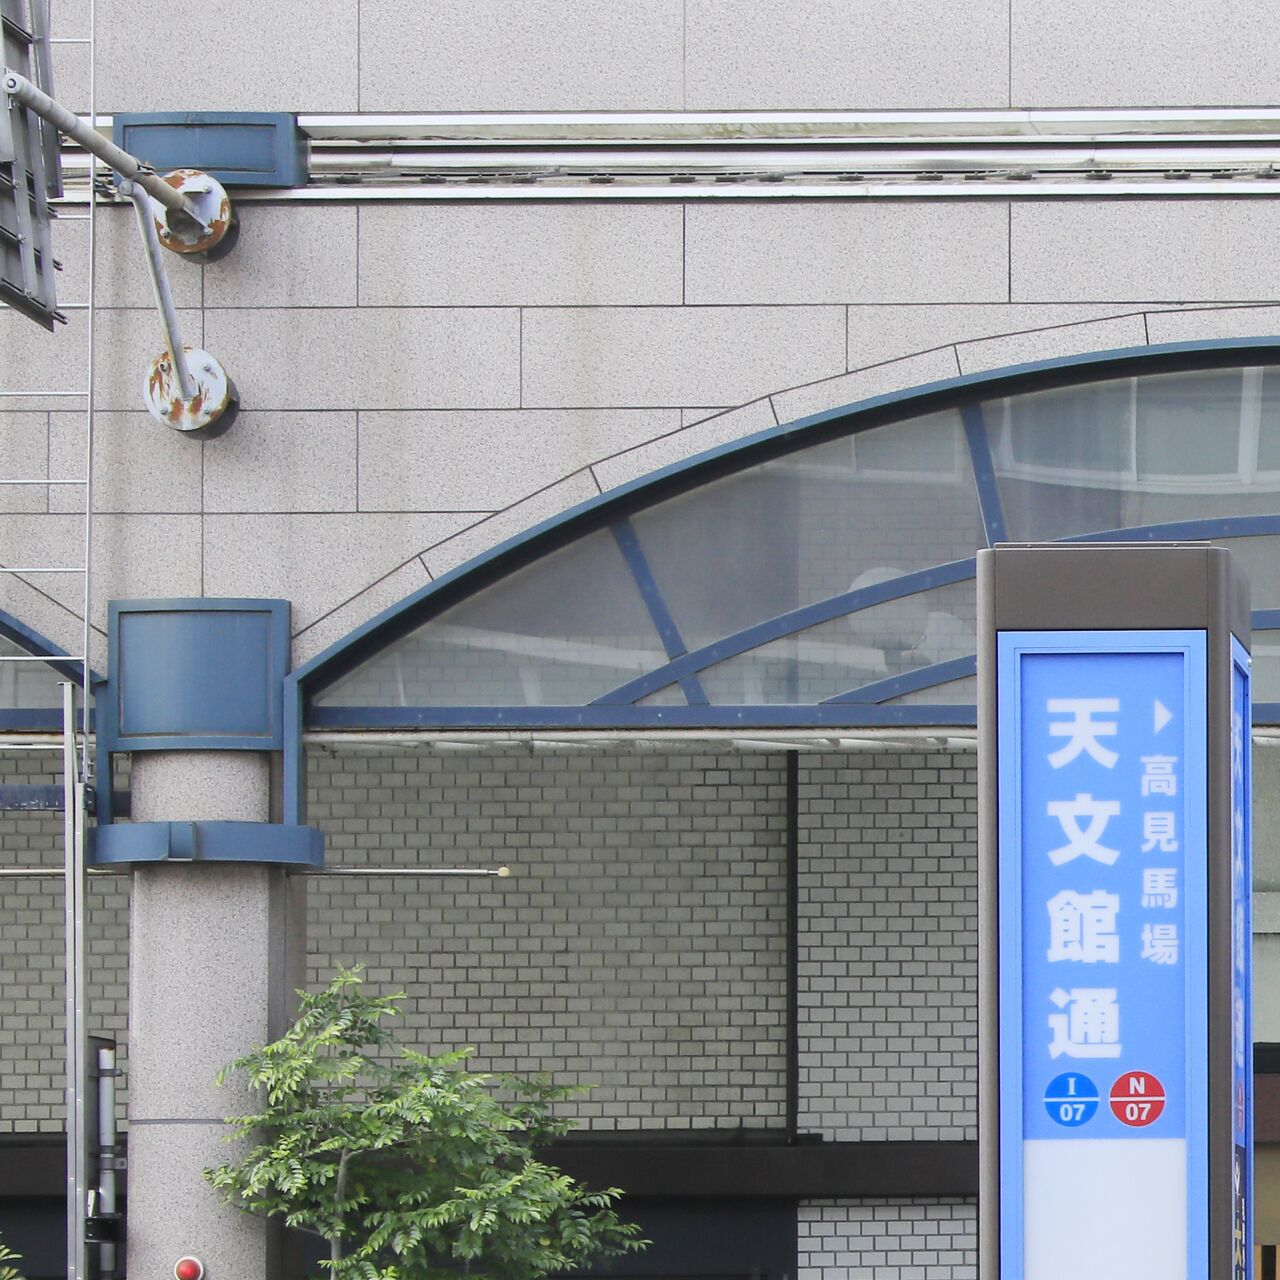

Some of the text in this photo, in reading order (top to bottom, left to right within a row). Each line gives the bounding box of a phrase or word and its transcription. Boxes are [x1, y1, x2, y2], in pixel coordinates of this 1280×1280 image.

[1140, 754, 1178, 966] 高見馬場
[1047, 698, 1122, 1061] 天文館通
[1129, 1077, 1145, 1095] N
[1060, 1103, 1086, 1122] 07
[1125, 1103, 1151, 1122] 07
